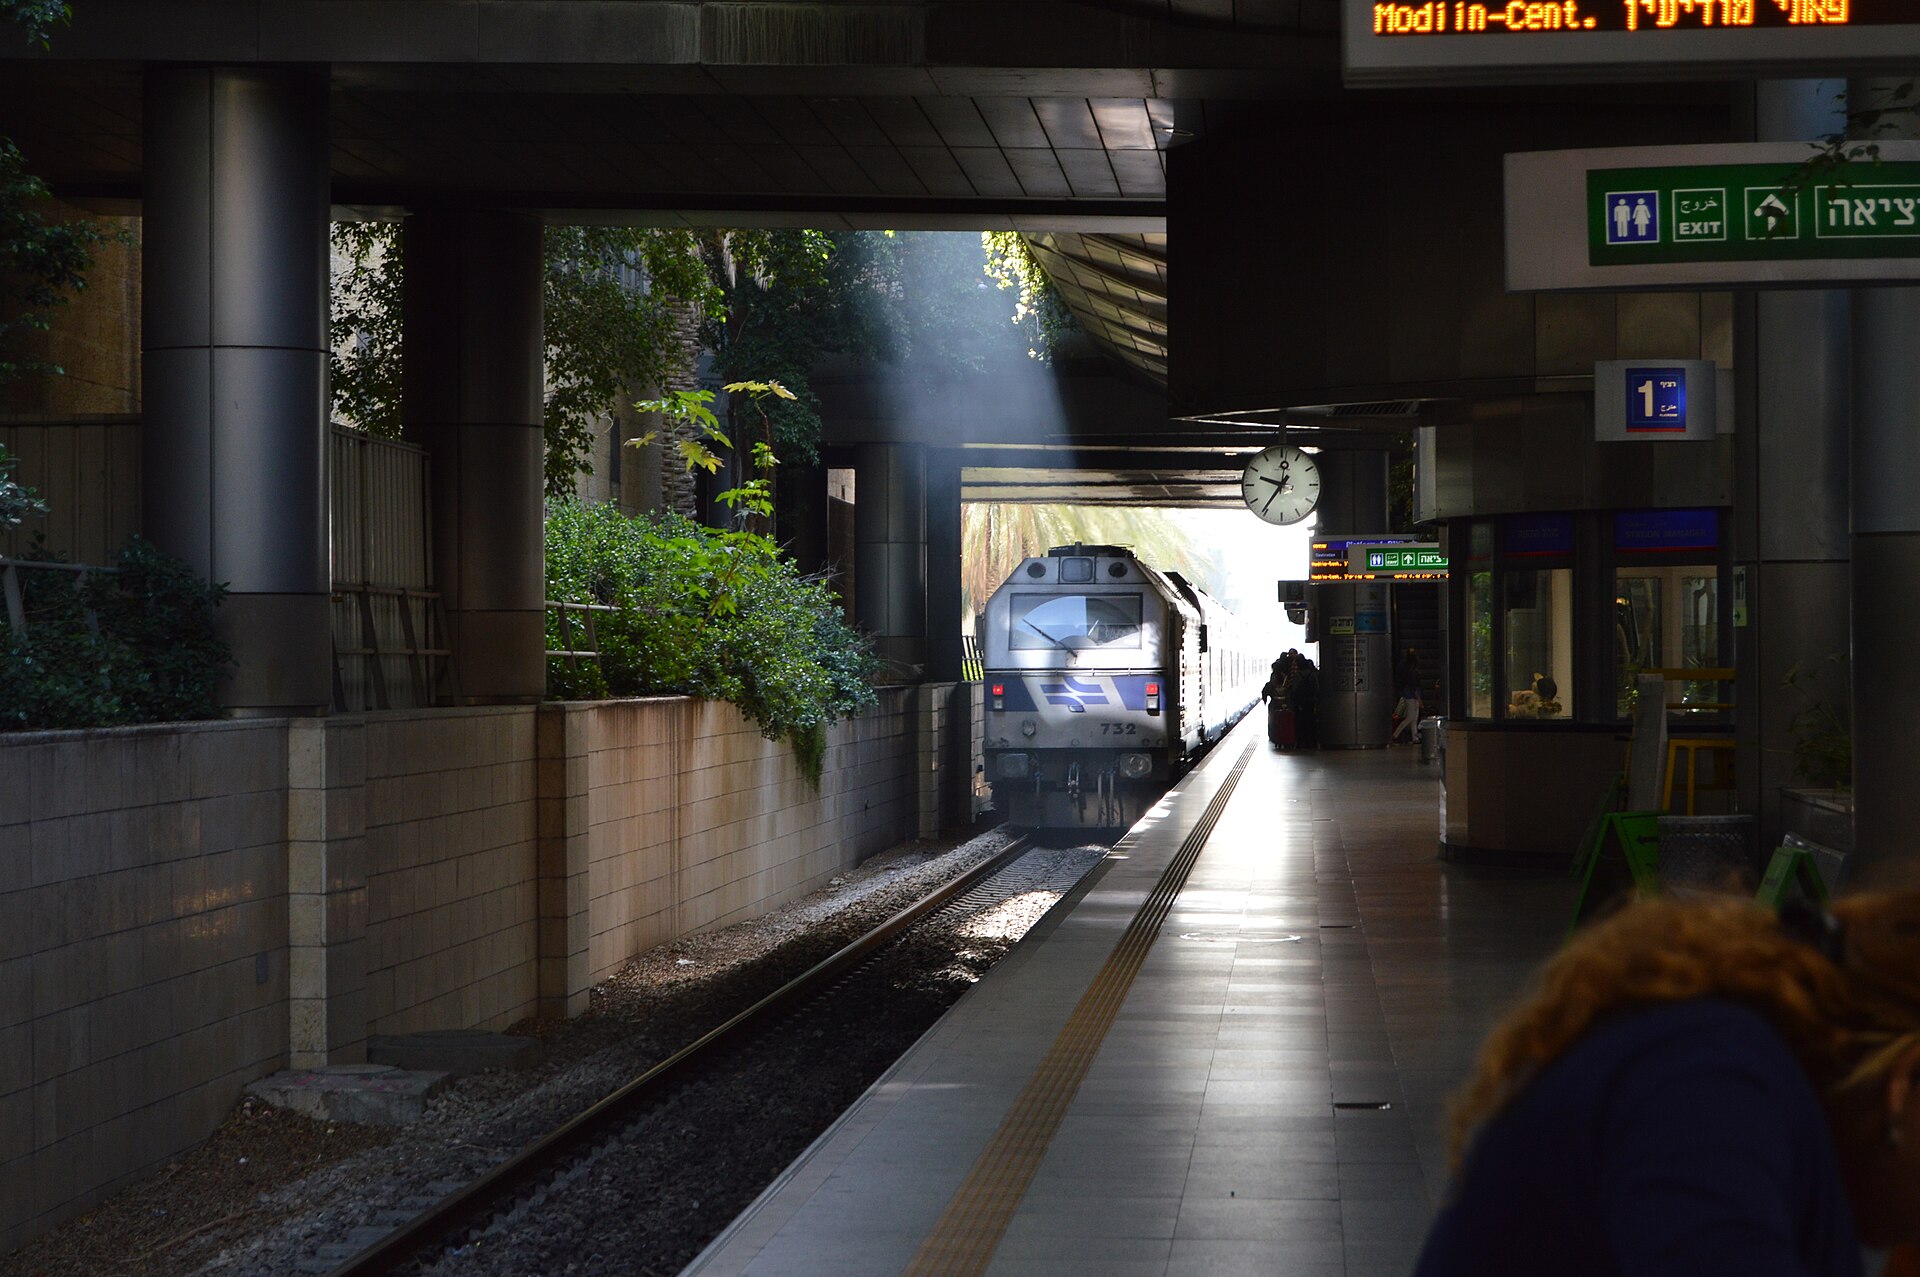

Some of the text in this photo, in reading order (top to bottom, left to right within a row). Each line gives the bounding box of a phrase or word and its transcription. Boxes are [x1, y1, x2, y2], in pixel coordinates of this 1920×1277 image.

[1679, 196, 1718, 214] خروج
[1678, 221, 1721, 235] EXIT
[1638, 380, 1654, 417] 1
[1100, 723, 1137, 735] 732
